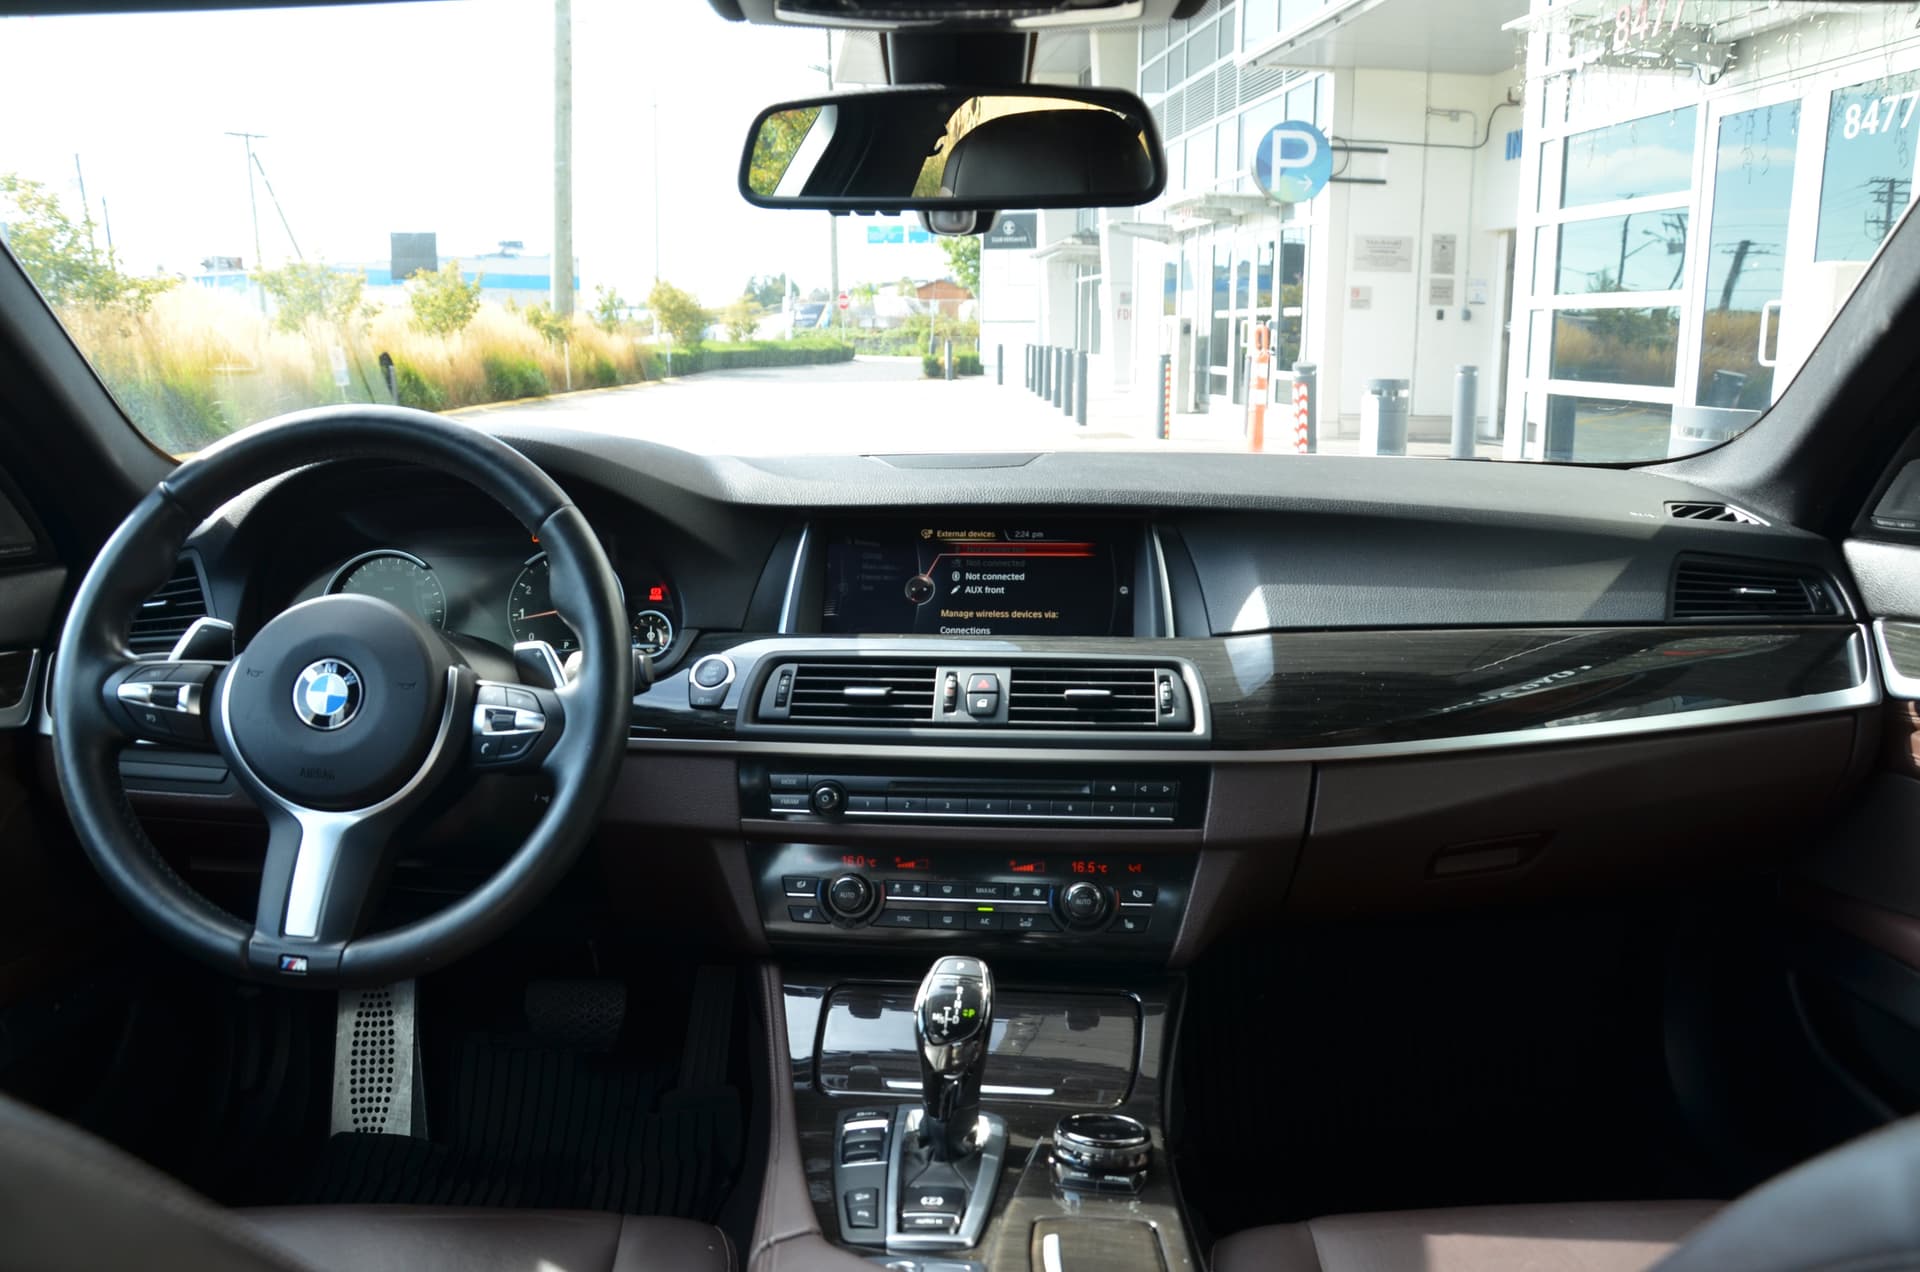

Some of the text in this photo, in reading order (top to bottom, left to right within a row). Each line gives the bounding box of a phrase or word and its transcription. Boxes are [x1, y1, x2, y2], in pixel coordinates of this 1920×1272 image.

[1843, 89, 1920, 139] 8477
[1270, 129, 1318, 193] P
[937, 530, 996, 538] External devices
[965, 573, 1025, 581] Not connected
[965, 585, 1005, 594] AUX front
[940, 609, 974, 619] Manage
[975, 609, 1009, 618] wireless
[1011, 610, 1042, 618] devices
[940, 626, 991, 635] Connections
[1072, 861, 1095, 873] 16.5
